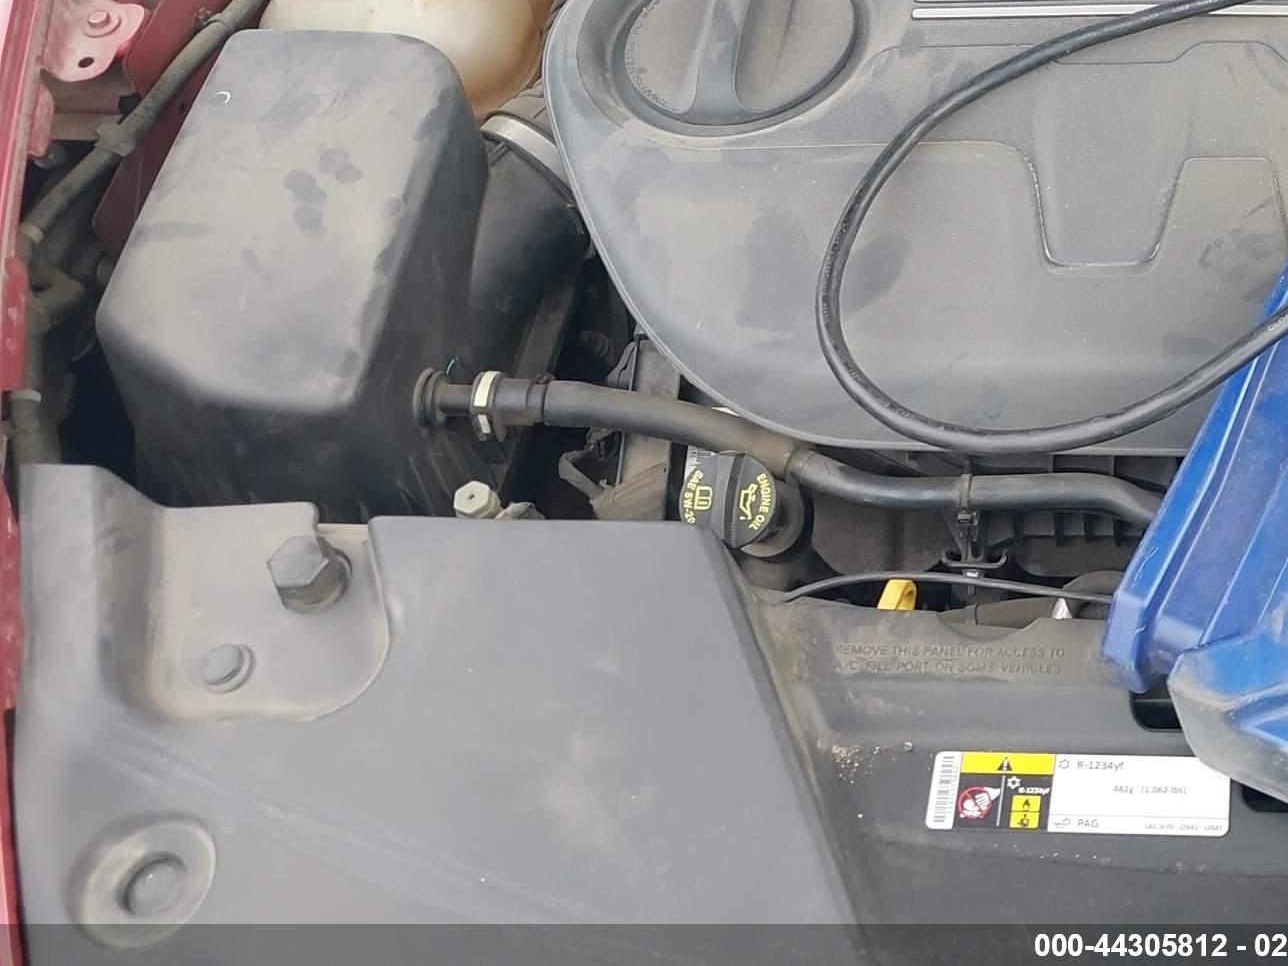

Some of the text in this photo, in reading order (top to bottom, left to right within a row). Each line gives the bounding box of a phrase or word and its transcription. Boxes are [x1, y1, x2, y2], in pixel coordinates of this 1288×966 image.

[687, 470, 704, 489] SAE
[683, 492, 696, 524] 5W-20
[748, 473, 771, 531] ENGINE OIL
[834, 643, 1065, 659] REMOVE THIS PANEL FOR ACCESS TO
[864, 661, 890, 672] FILL
[896, 661, 928, 673] PORT
[935, 661, 953, 673] ON
[958, 662, 993, 674] SOME
[999, 663, 1062, 674] VEHICLES
[1077, 761, 1125, 772] R-1234yf
[1113, 785, 1187, 795] 482g (1.062 lbs)
[1077, 819, 1099, 829] PAG
